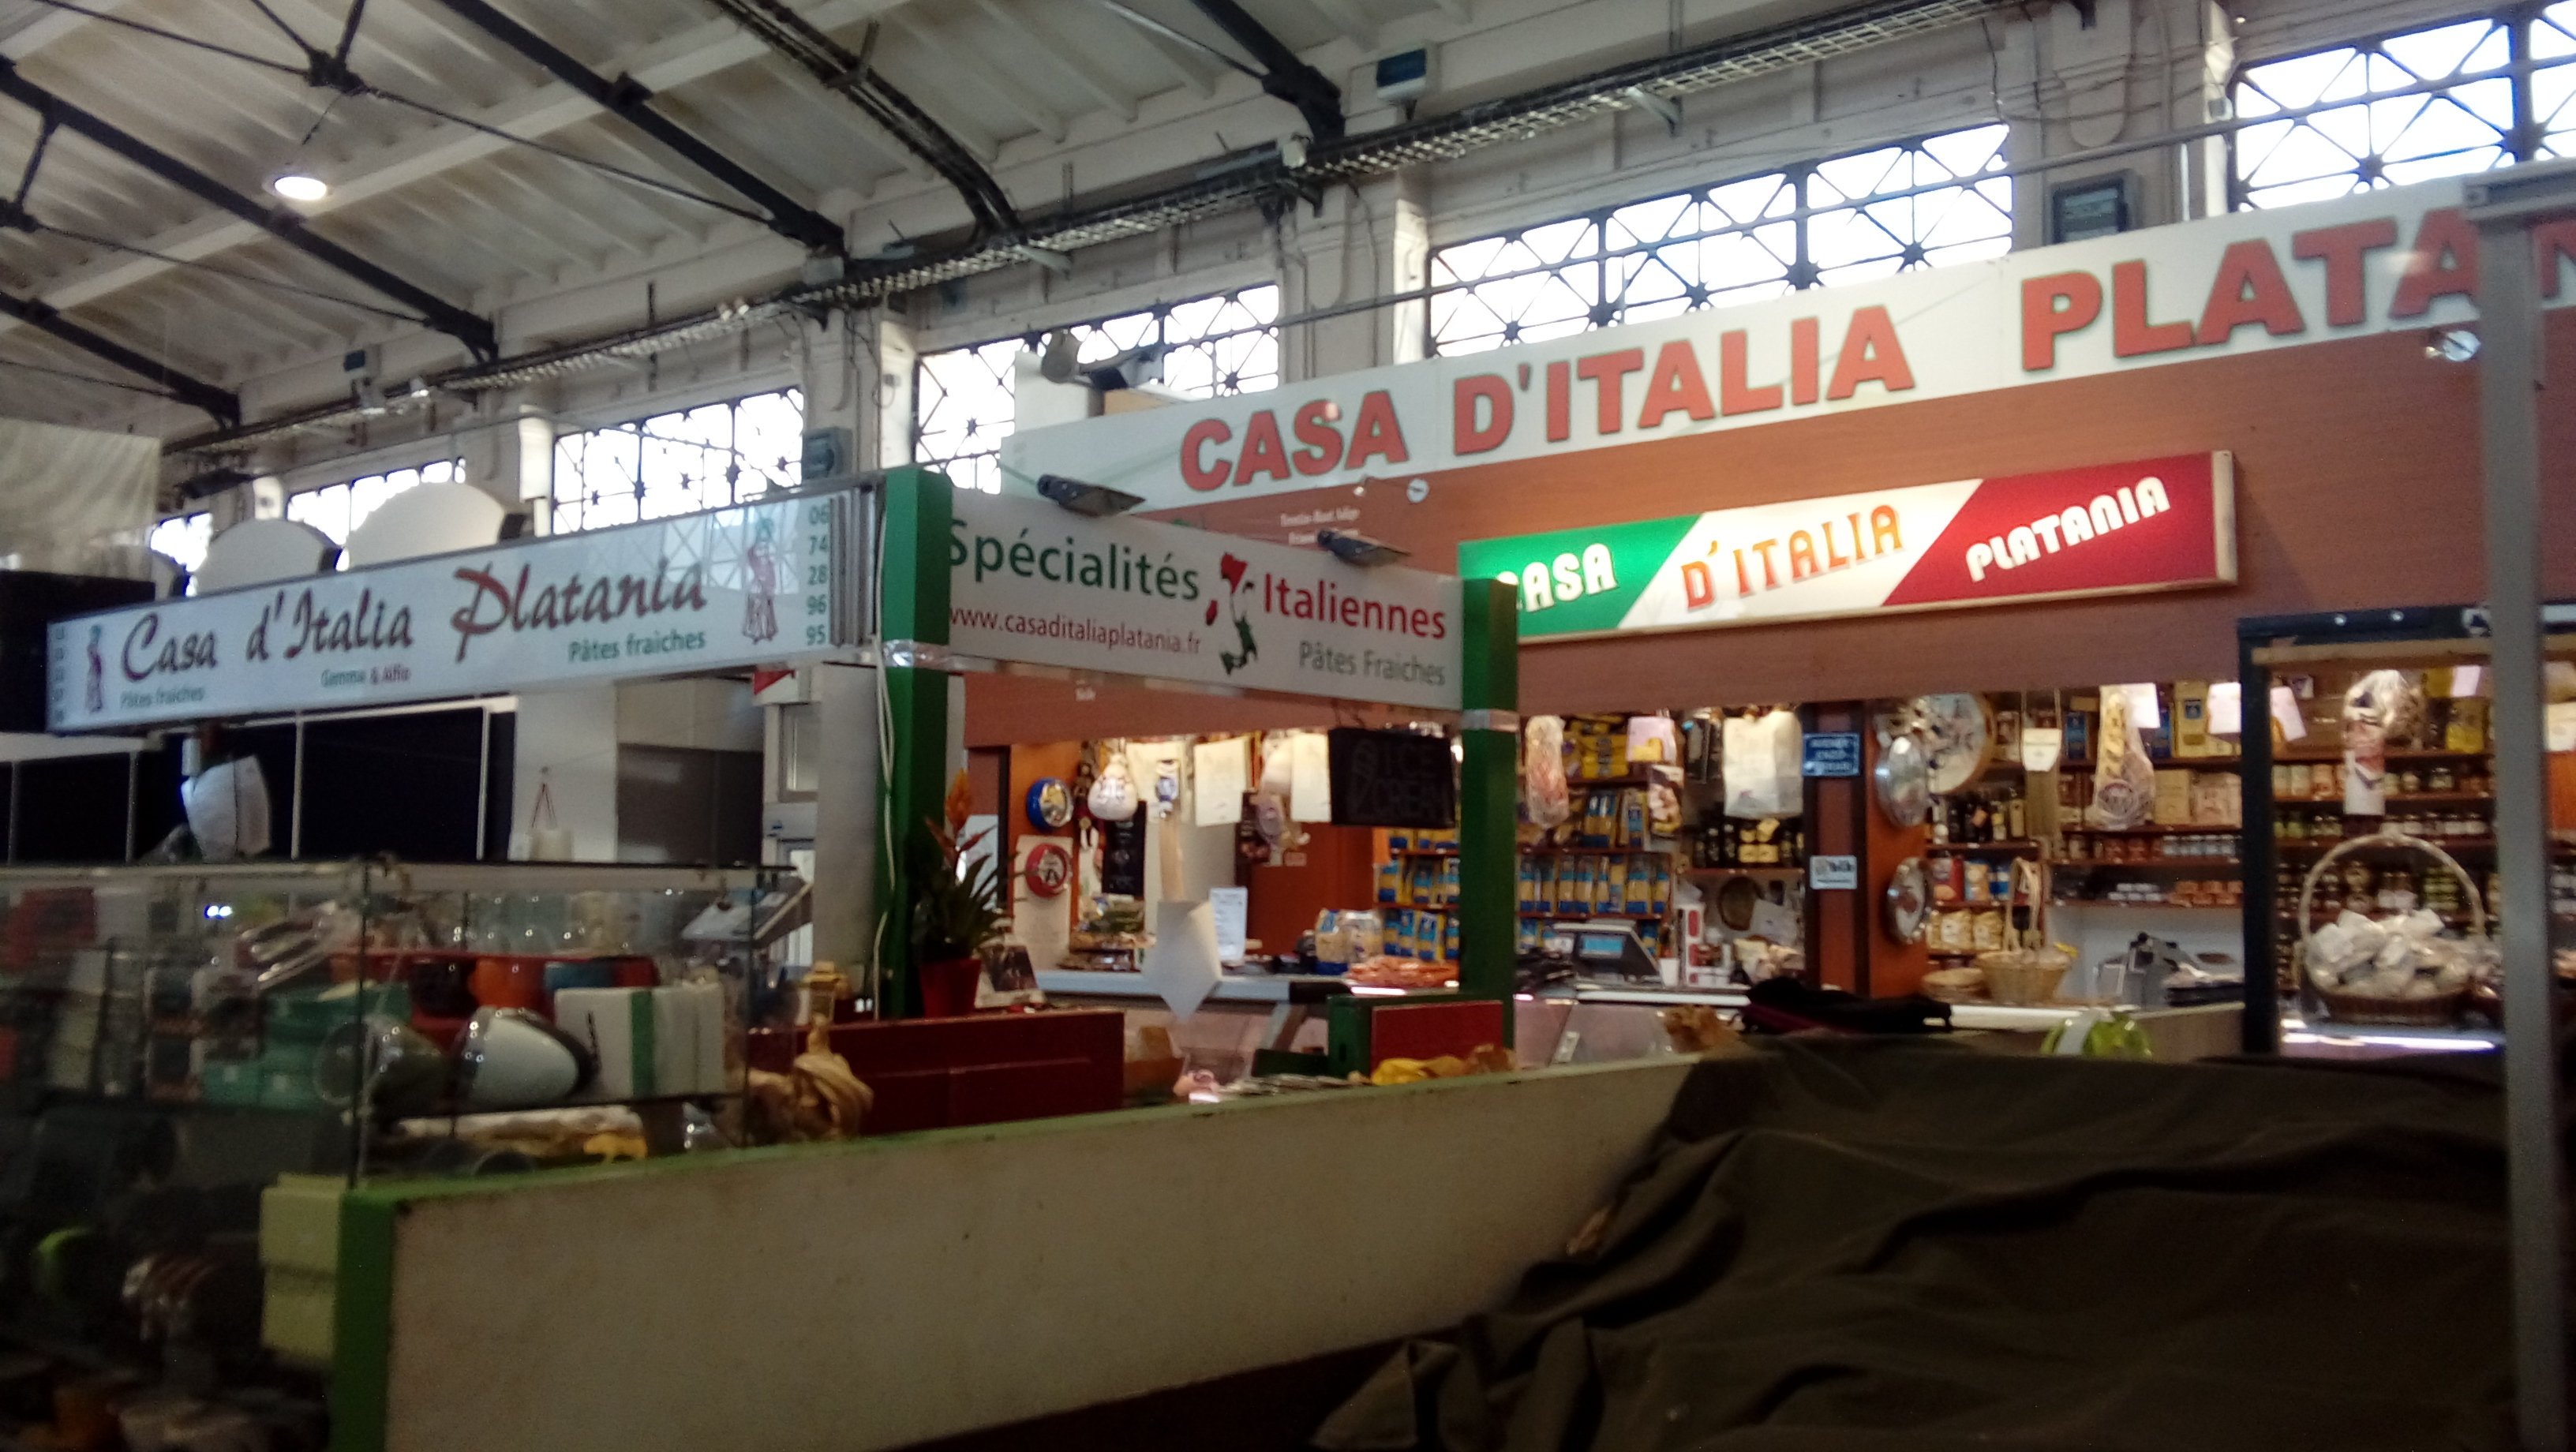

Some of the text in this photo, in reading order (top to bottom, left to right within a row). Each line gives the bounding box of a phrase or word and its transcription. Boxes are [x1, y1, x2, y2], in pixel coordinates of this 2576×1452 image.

[1180, 390, 1410, 491] CASA
[1453, 305, 1915, 457] D'ITALIA
[948, 518, 1446, 639] Spécialités Italiennes
[1680, 504, 1904, 612] D'ITALIA
[1966, 476, 2170, 582] PLATANIA
[122, 612, 217, 682] Casa
[245, 587, 413, 660] d'Italia
[451, 560, 707, 662] Platania
[806, 623, 826, 646] 95
[807, 593, 827, 616] 96
[950, 607, 1201, 654] www.casaditaliaplatania.fr
[1299, 640, 1357, 675] Pâtes
